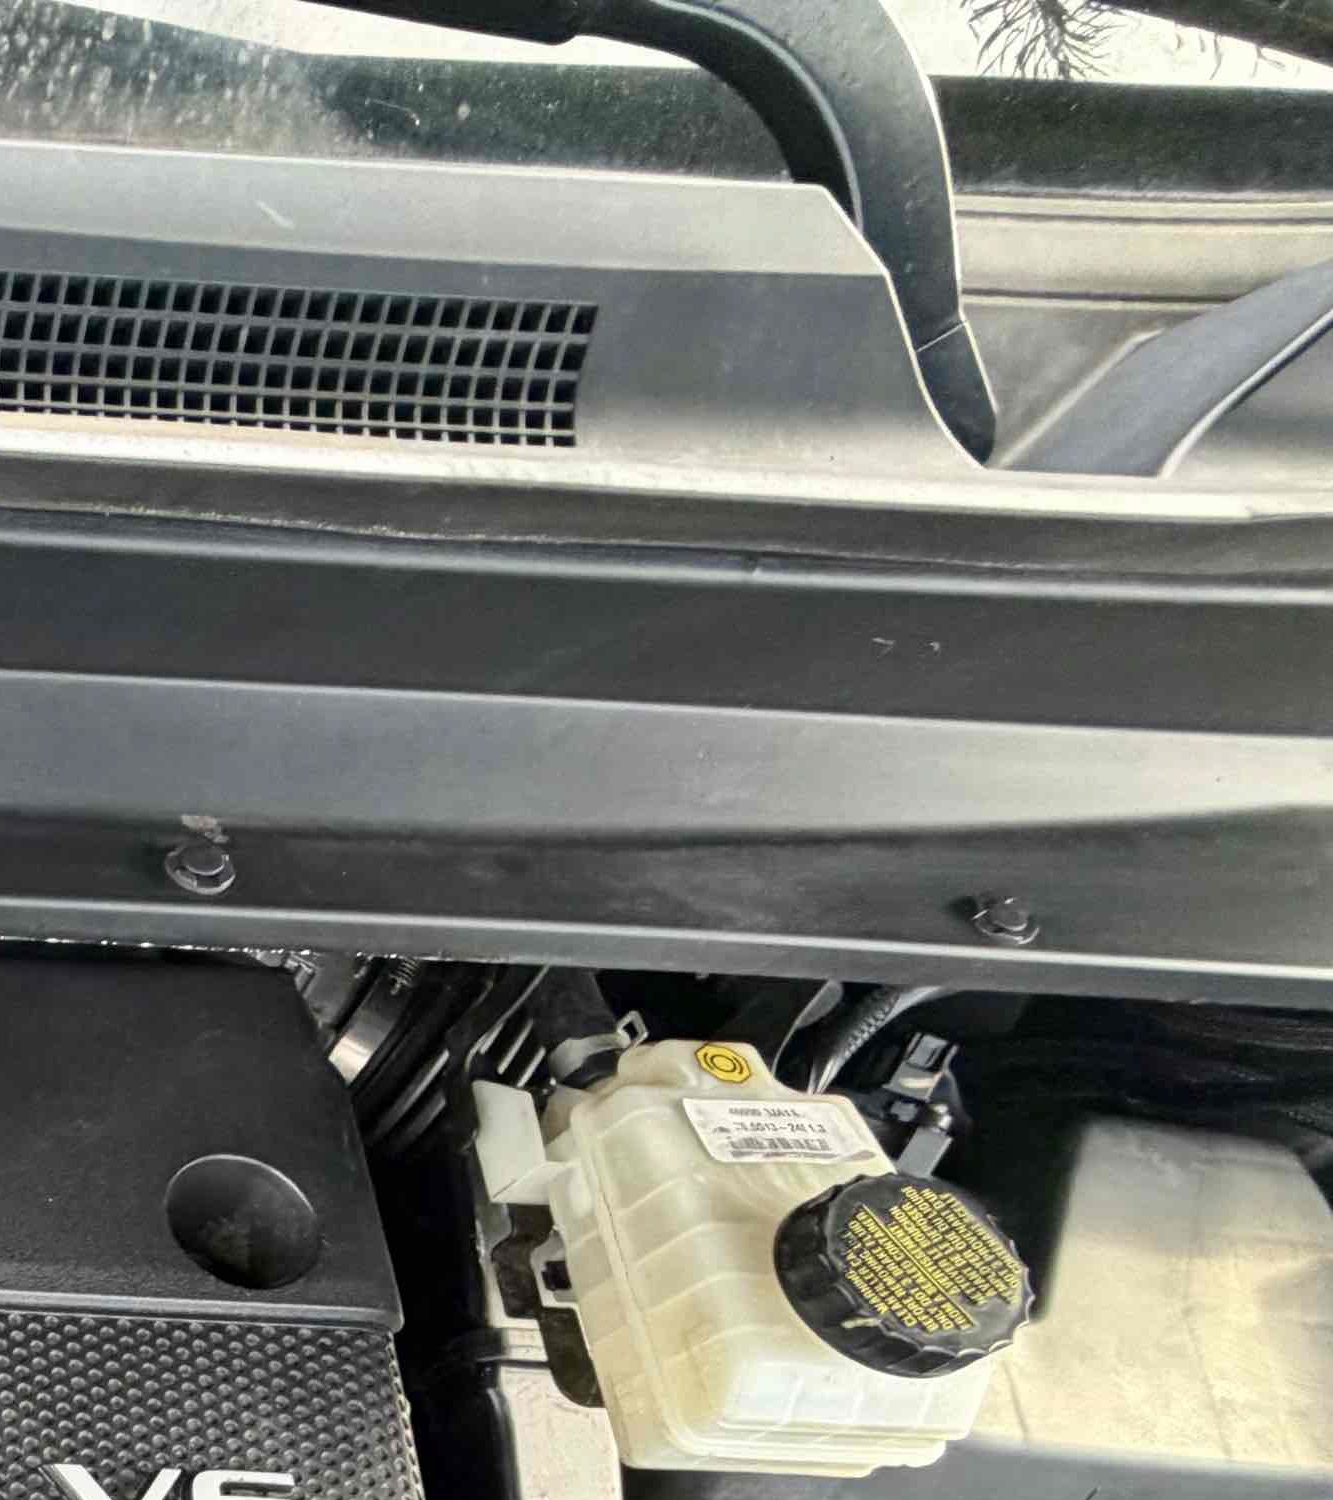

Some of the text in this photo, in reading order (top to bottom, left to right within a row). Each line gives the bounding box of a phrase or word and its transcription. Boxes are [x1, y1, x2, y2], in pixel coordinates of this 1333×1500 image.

[845, 1218, 876, 1247] FLUID
[887, 1204, 932, 1248] BOUCHON
[870, 1245, 904, 1276] BRAKE
[899, 1258, 938, 1295] SEALED
[961, 1266, 997, 1299] AVANT
[882, 1294, 918, 1327] CLEAN
[899, 1294, 940, 1332] BEFORE
[925, 1304, 954, 1330] ONLY
[939, 1301, 972, 1331] FROM
